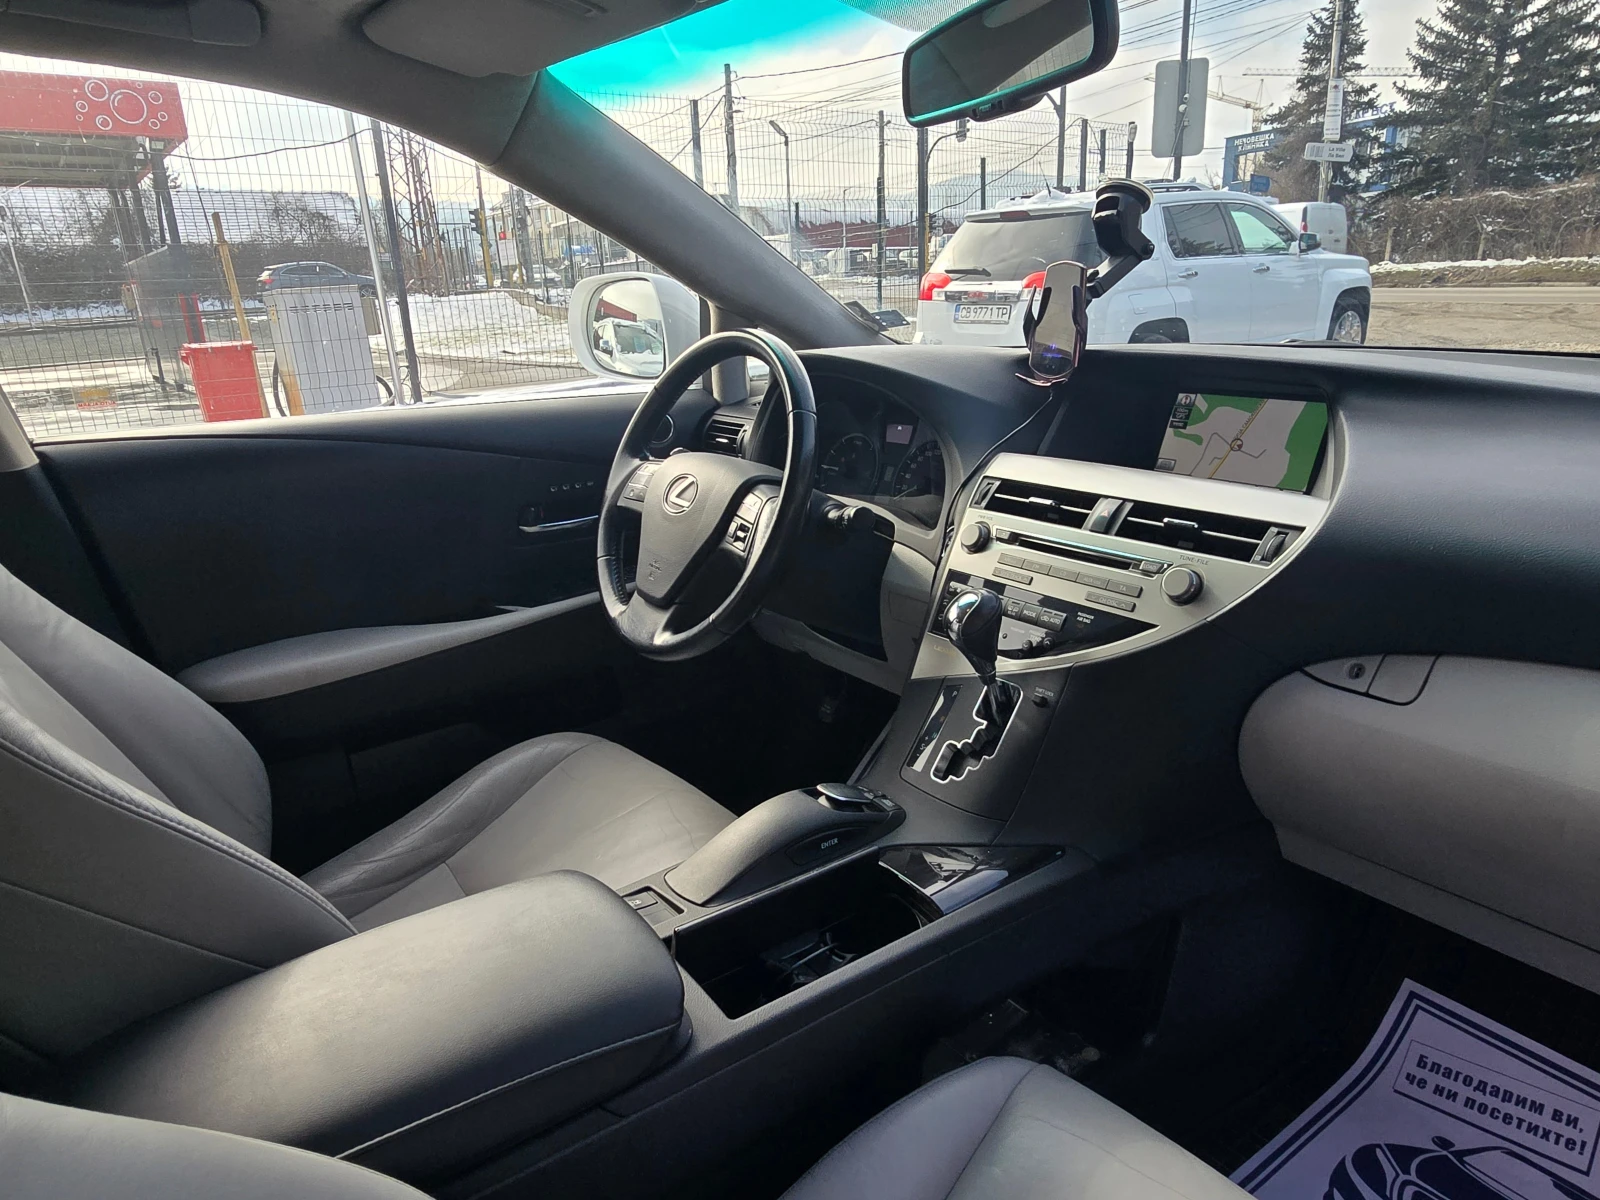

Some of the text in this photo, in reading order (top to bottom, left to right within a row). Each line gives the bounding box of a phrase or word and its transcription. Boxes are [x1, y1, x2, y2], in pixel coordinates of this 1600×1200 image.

[960, 306, 1008, 319] CB 9771 TP
[1022, 609, 1037, 618] MODE
[1050, 617, 1061, 625] AUTO
[820, 837, 839, 849] ENTER
[1416, 1053, 1545, 1116] Благодарим
[1404, 1071, 1588, 1156] че ни посетихте!
